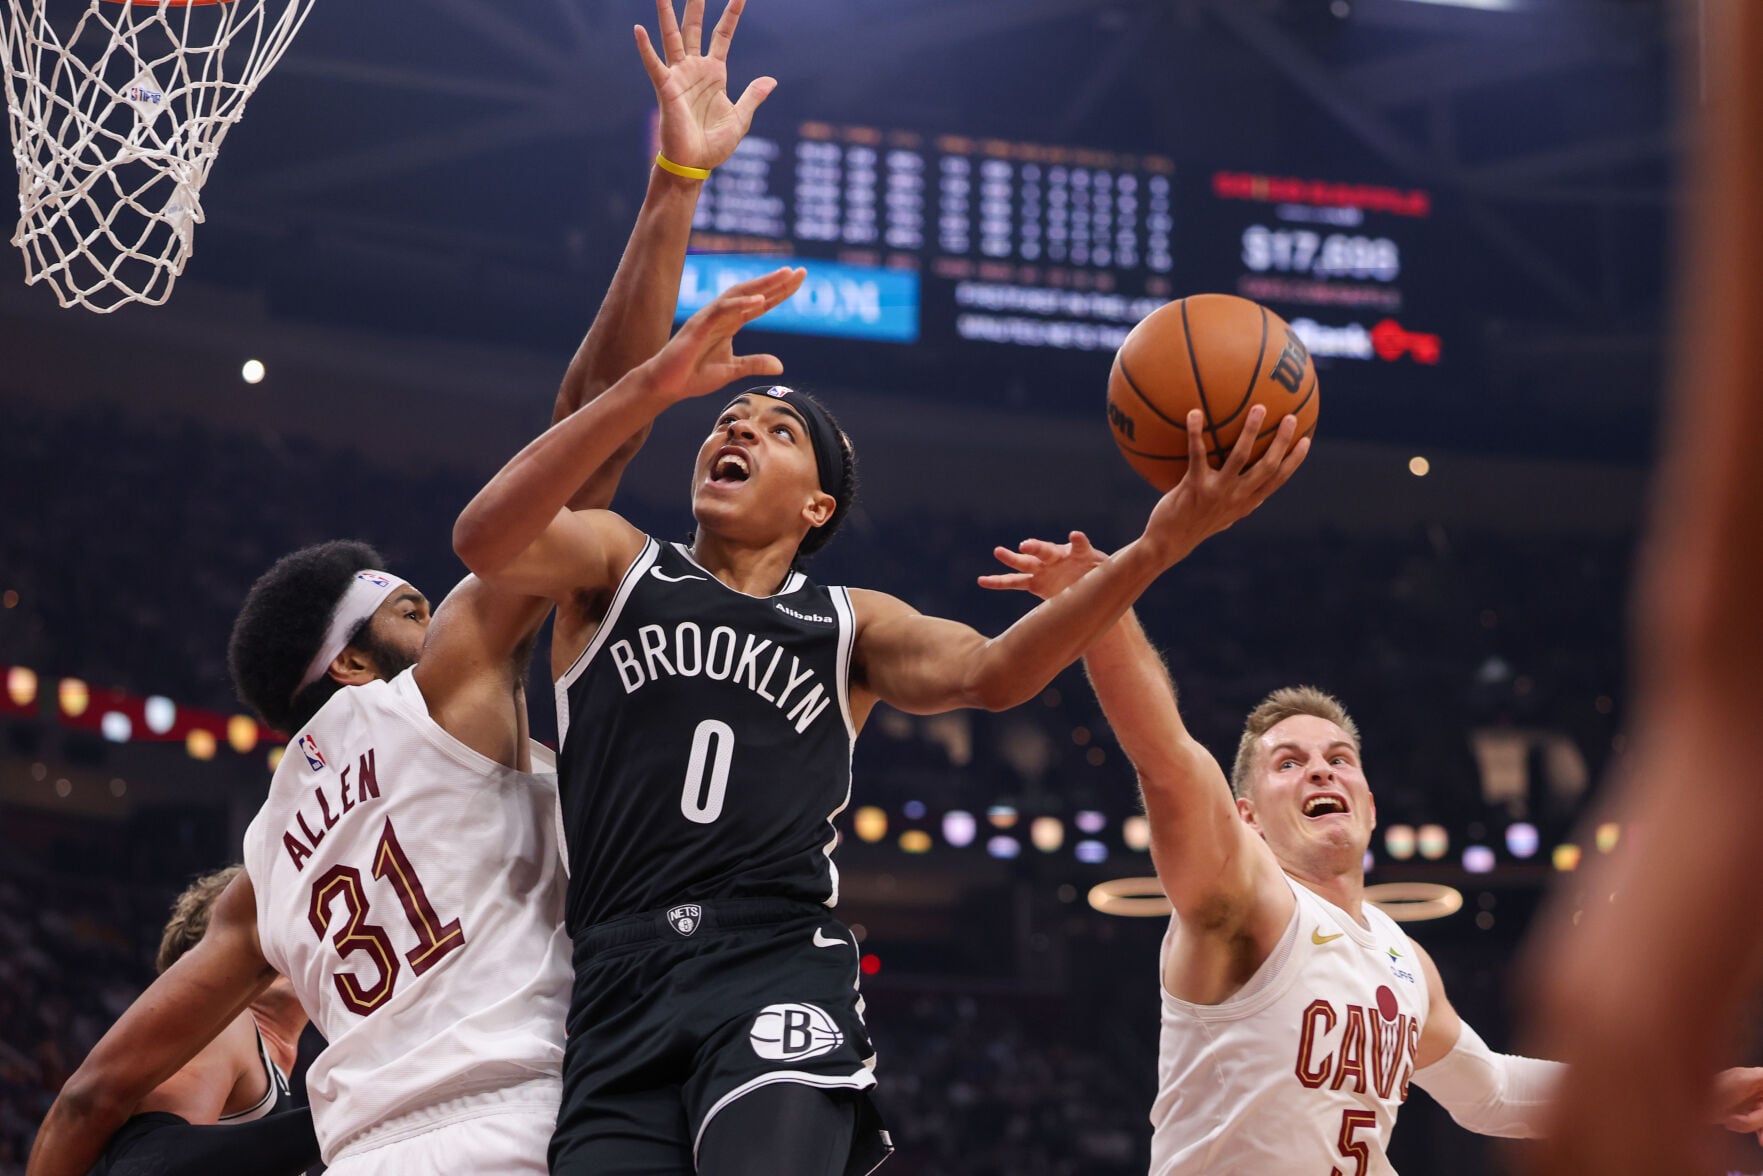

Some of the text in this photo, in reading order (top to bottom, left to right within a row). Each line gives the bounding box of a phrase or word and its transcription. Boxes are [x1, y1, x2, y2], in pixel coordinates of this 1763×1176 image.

[775, 603, 833, 623] Alibaba
[609, 622, 831, 734] BROOKLYN
[283, 748, 381, 872] ALLEN
[681, 719, 735, 824] 0
[308, 815, 465, 1016] 31
[670, 907, 699, 921] NETS
[783, 1010, 812, 1054] B
[1331, 1110, 1376, 1176] 5
